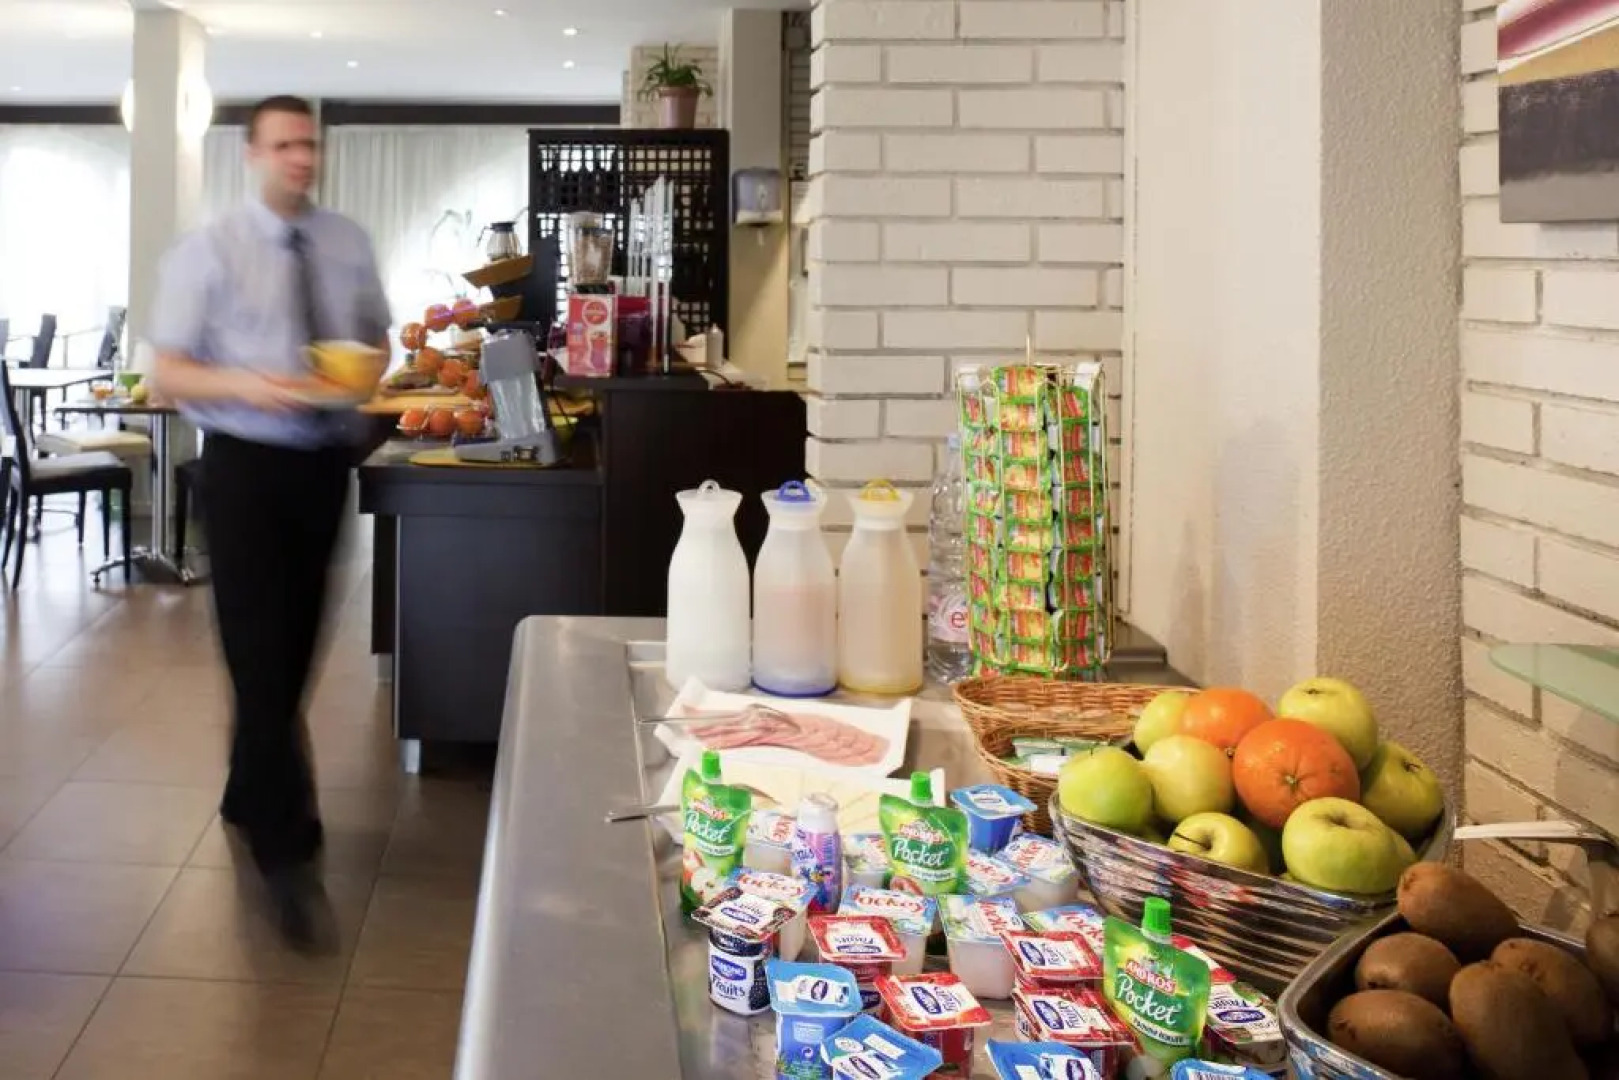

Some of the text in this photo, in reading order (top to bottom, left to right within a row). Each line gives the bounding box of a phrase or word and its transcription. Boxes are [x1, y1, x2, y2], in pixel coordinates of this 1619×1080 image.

[685, 811, 729, 843] Pocket
[892, 836, 944, 866] Pocket
[1117, 972, 1179, 1025] Pocket
